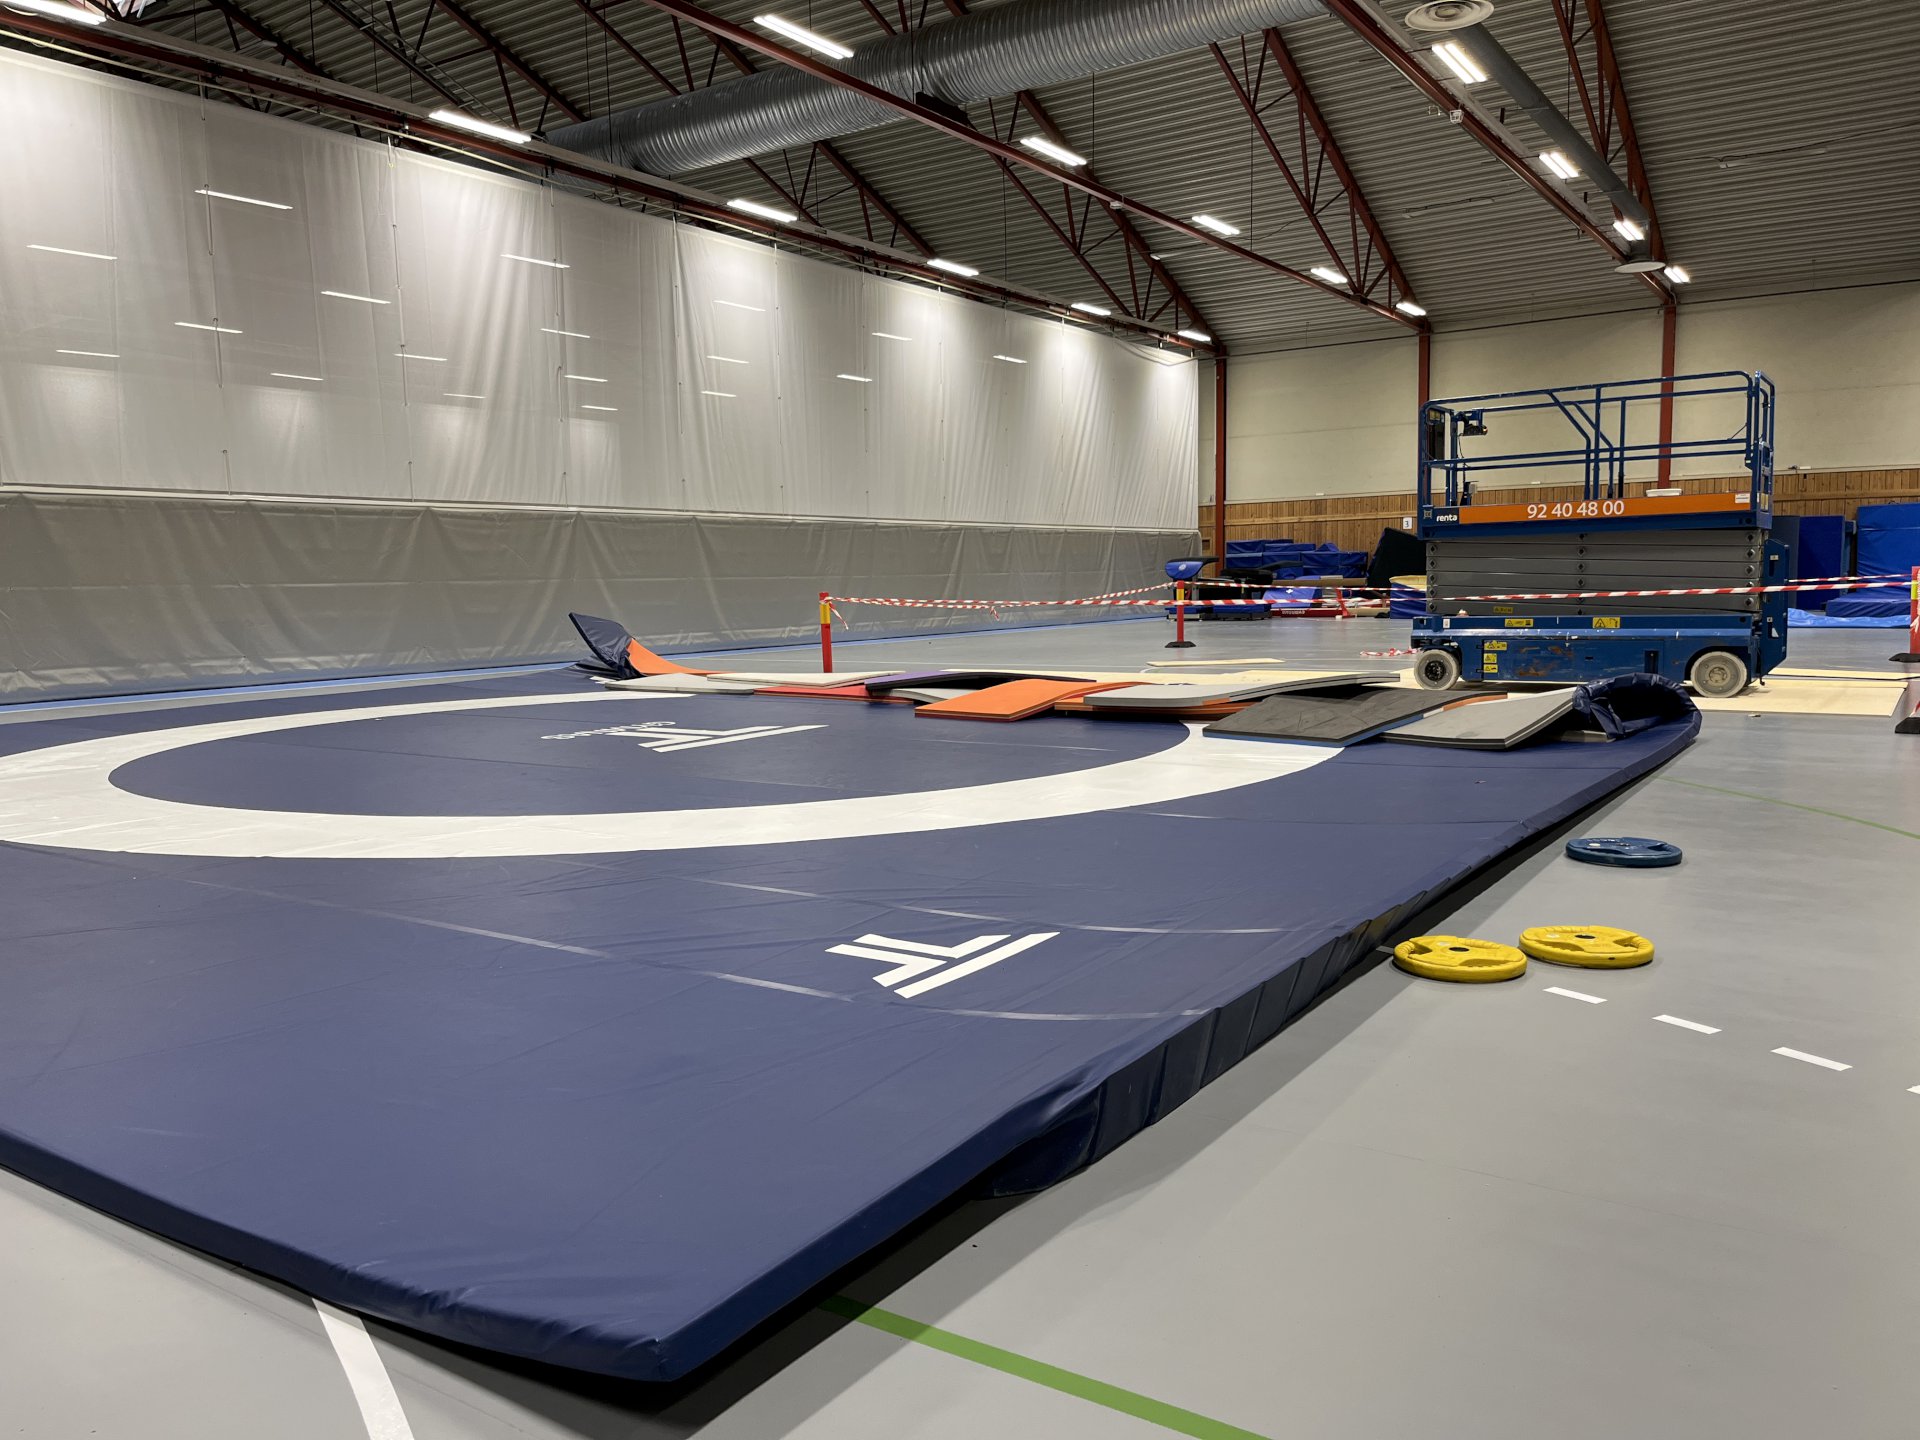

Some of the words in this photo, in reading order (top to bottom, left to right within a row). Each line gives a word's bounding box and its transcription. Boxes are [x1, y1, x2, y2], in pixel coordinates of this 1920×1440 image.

[1527, 504, 1547, 519] 92
[1551, 502, 1573, 518] 40
[1576, 501, 1598, 516] 48
[1602, 500, 1625, 515] 00
[1436, 514, 1458, 522] renta
